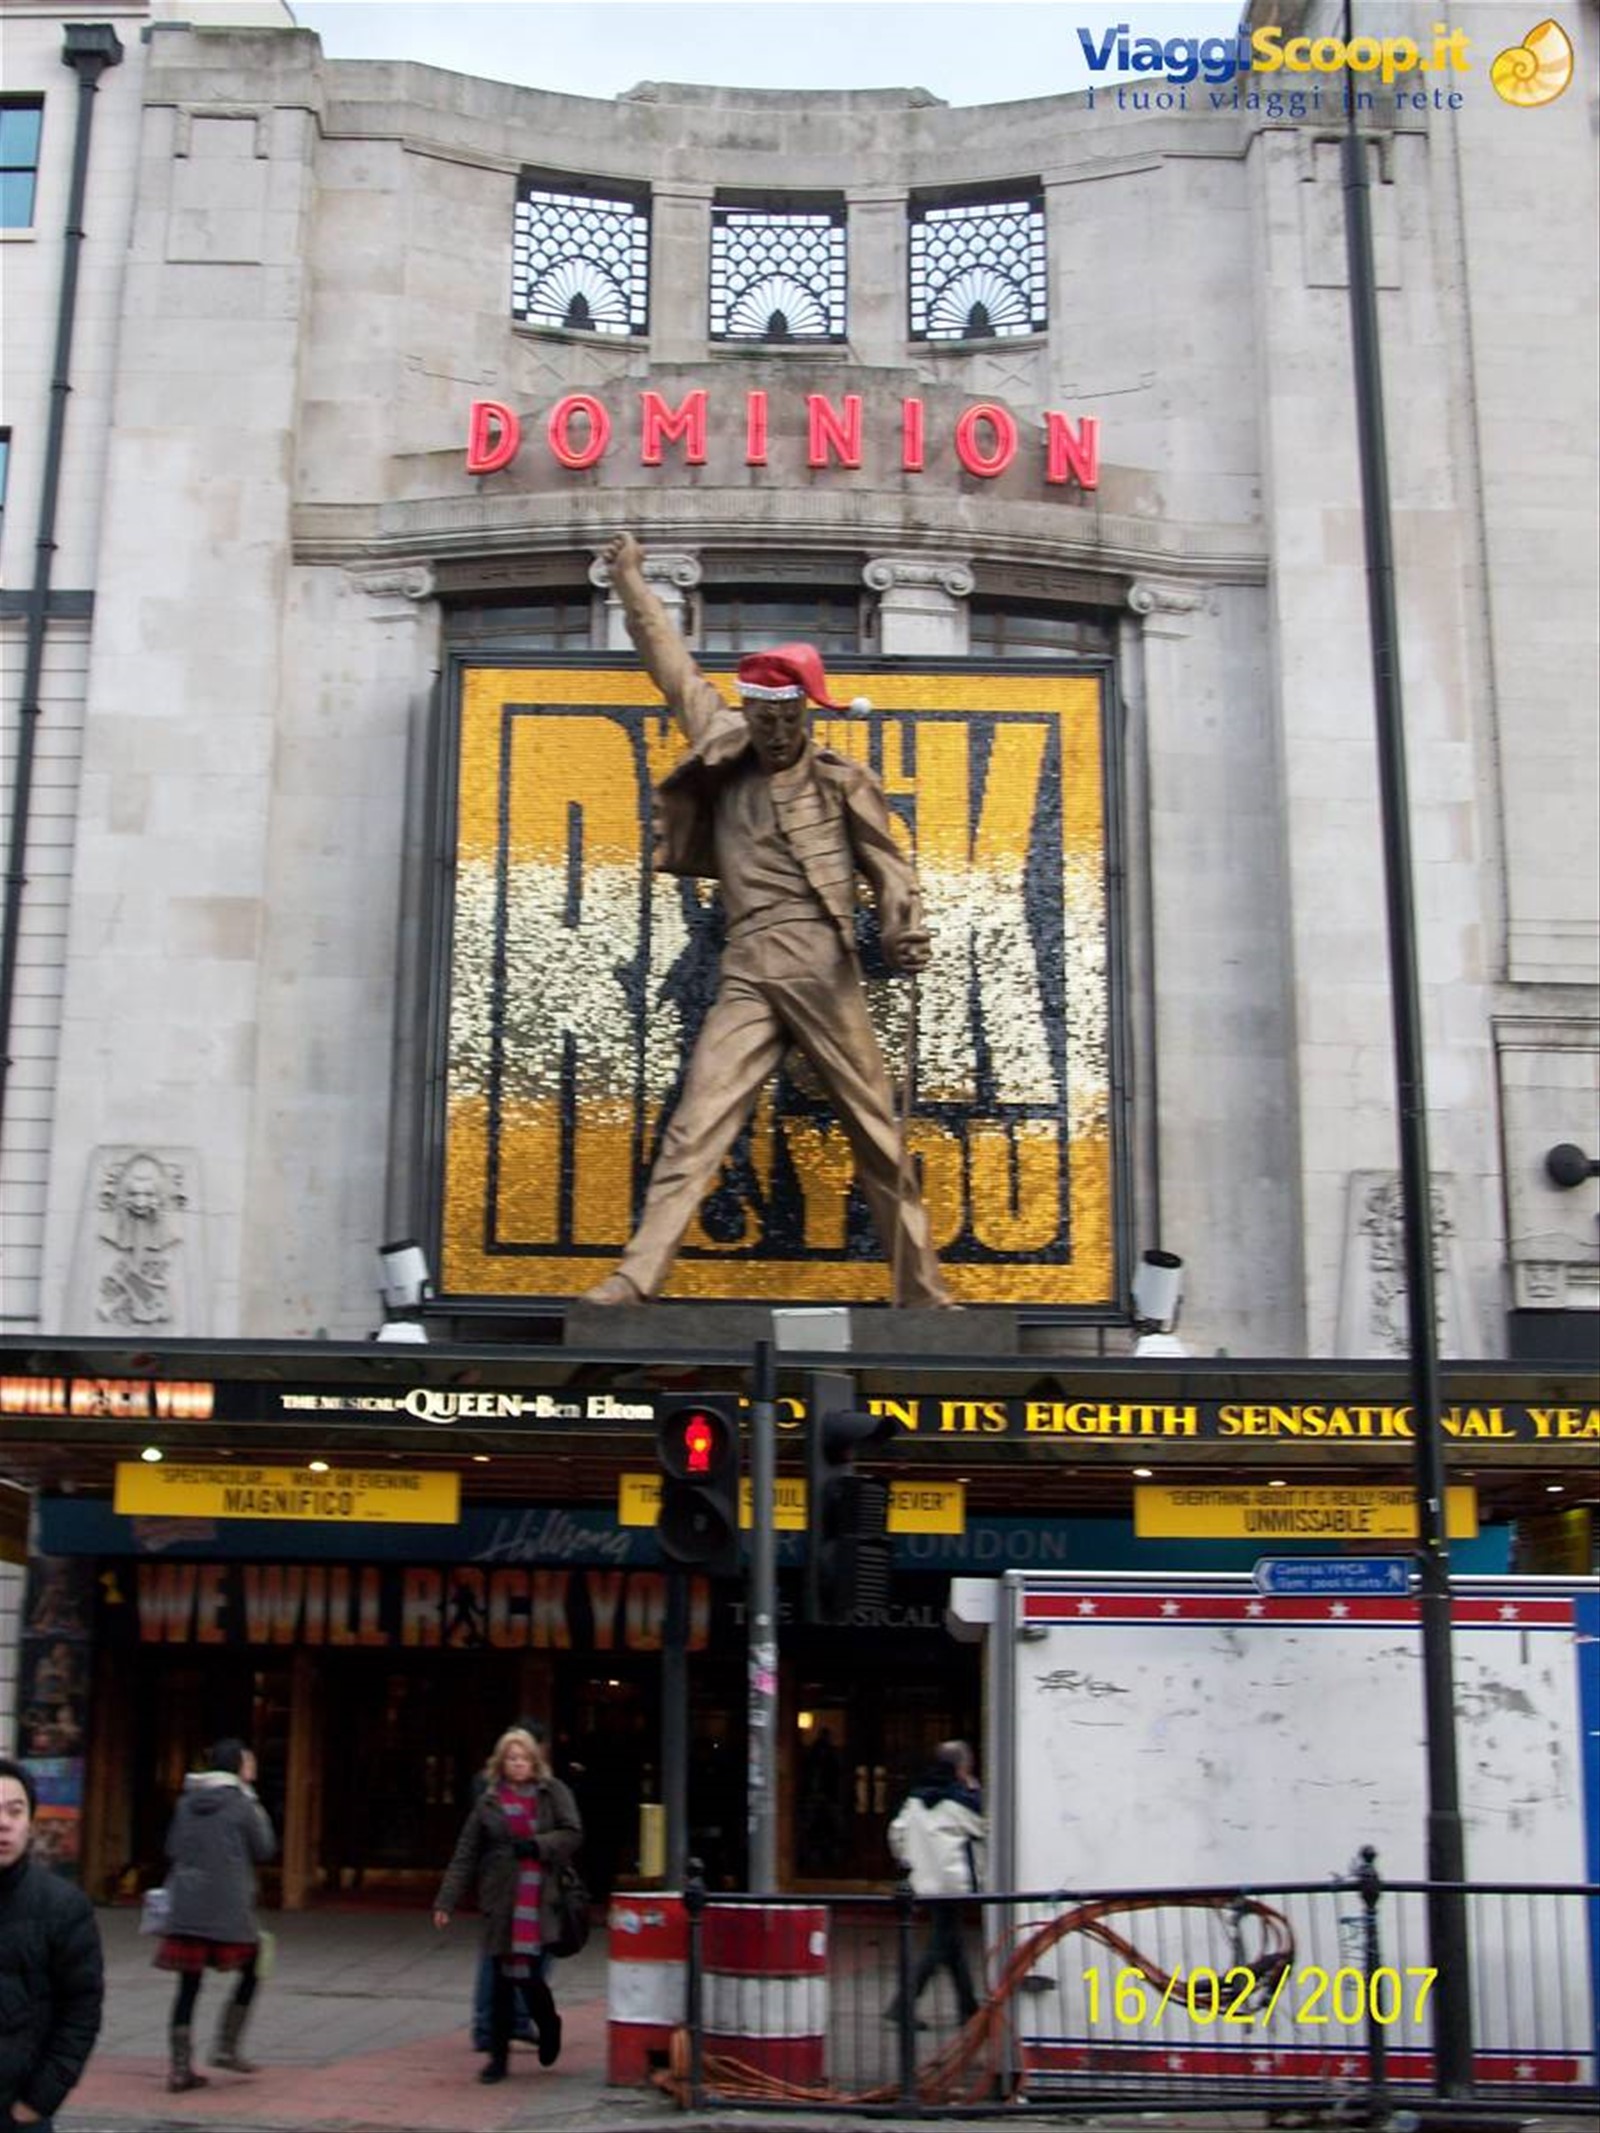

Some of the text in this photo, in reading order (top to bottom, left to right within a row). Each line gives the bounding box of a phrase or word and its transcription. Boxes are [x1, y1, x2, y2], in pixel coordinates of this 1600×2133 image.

[466, 389, 1101, 490] DOMINION
[70, 1378, 150, 1417] ROCK
[154, 1381, 215, 1420] YOU
[939, 1401, 1008, 1432] ITS
[1024, 1402, 1197, 1435] EIGHTH
[891, 1529, 1068, 1560] ONDON
[137, 1562, 229, 1645] WE
[242, 1562, 390, 1647] WILL
[397, 1564, 574, 1651] ROCK
